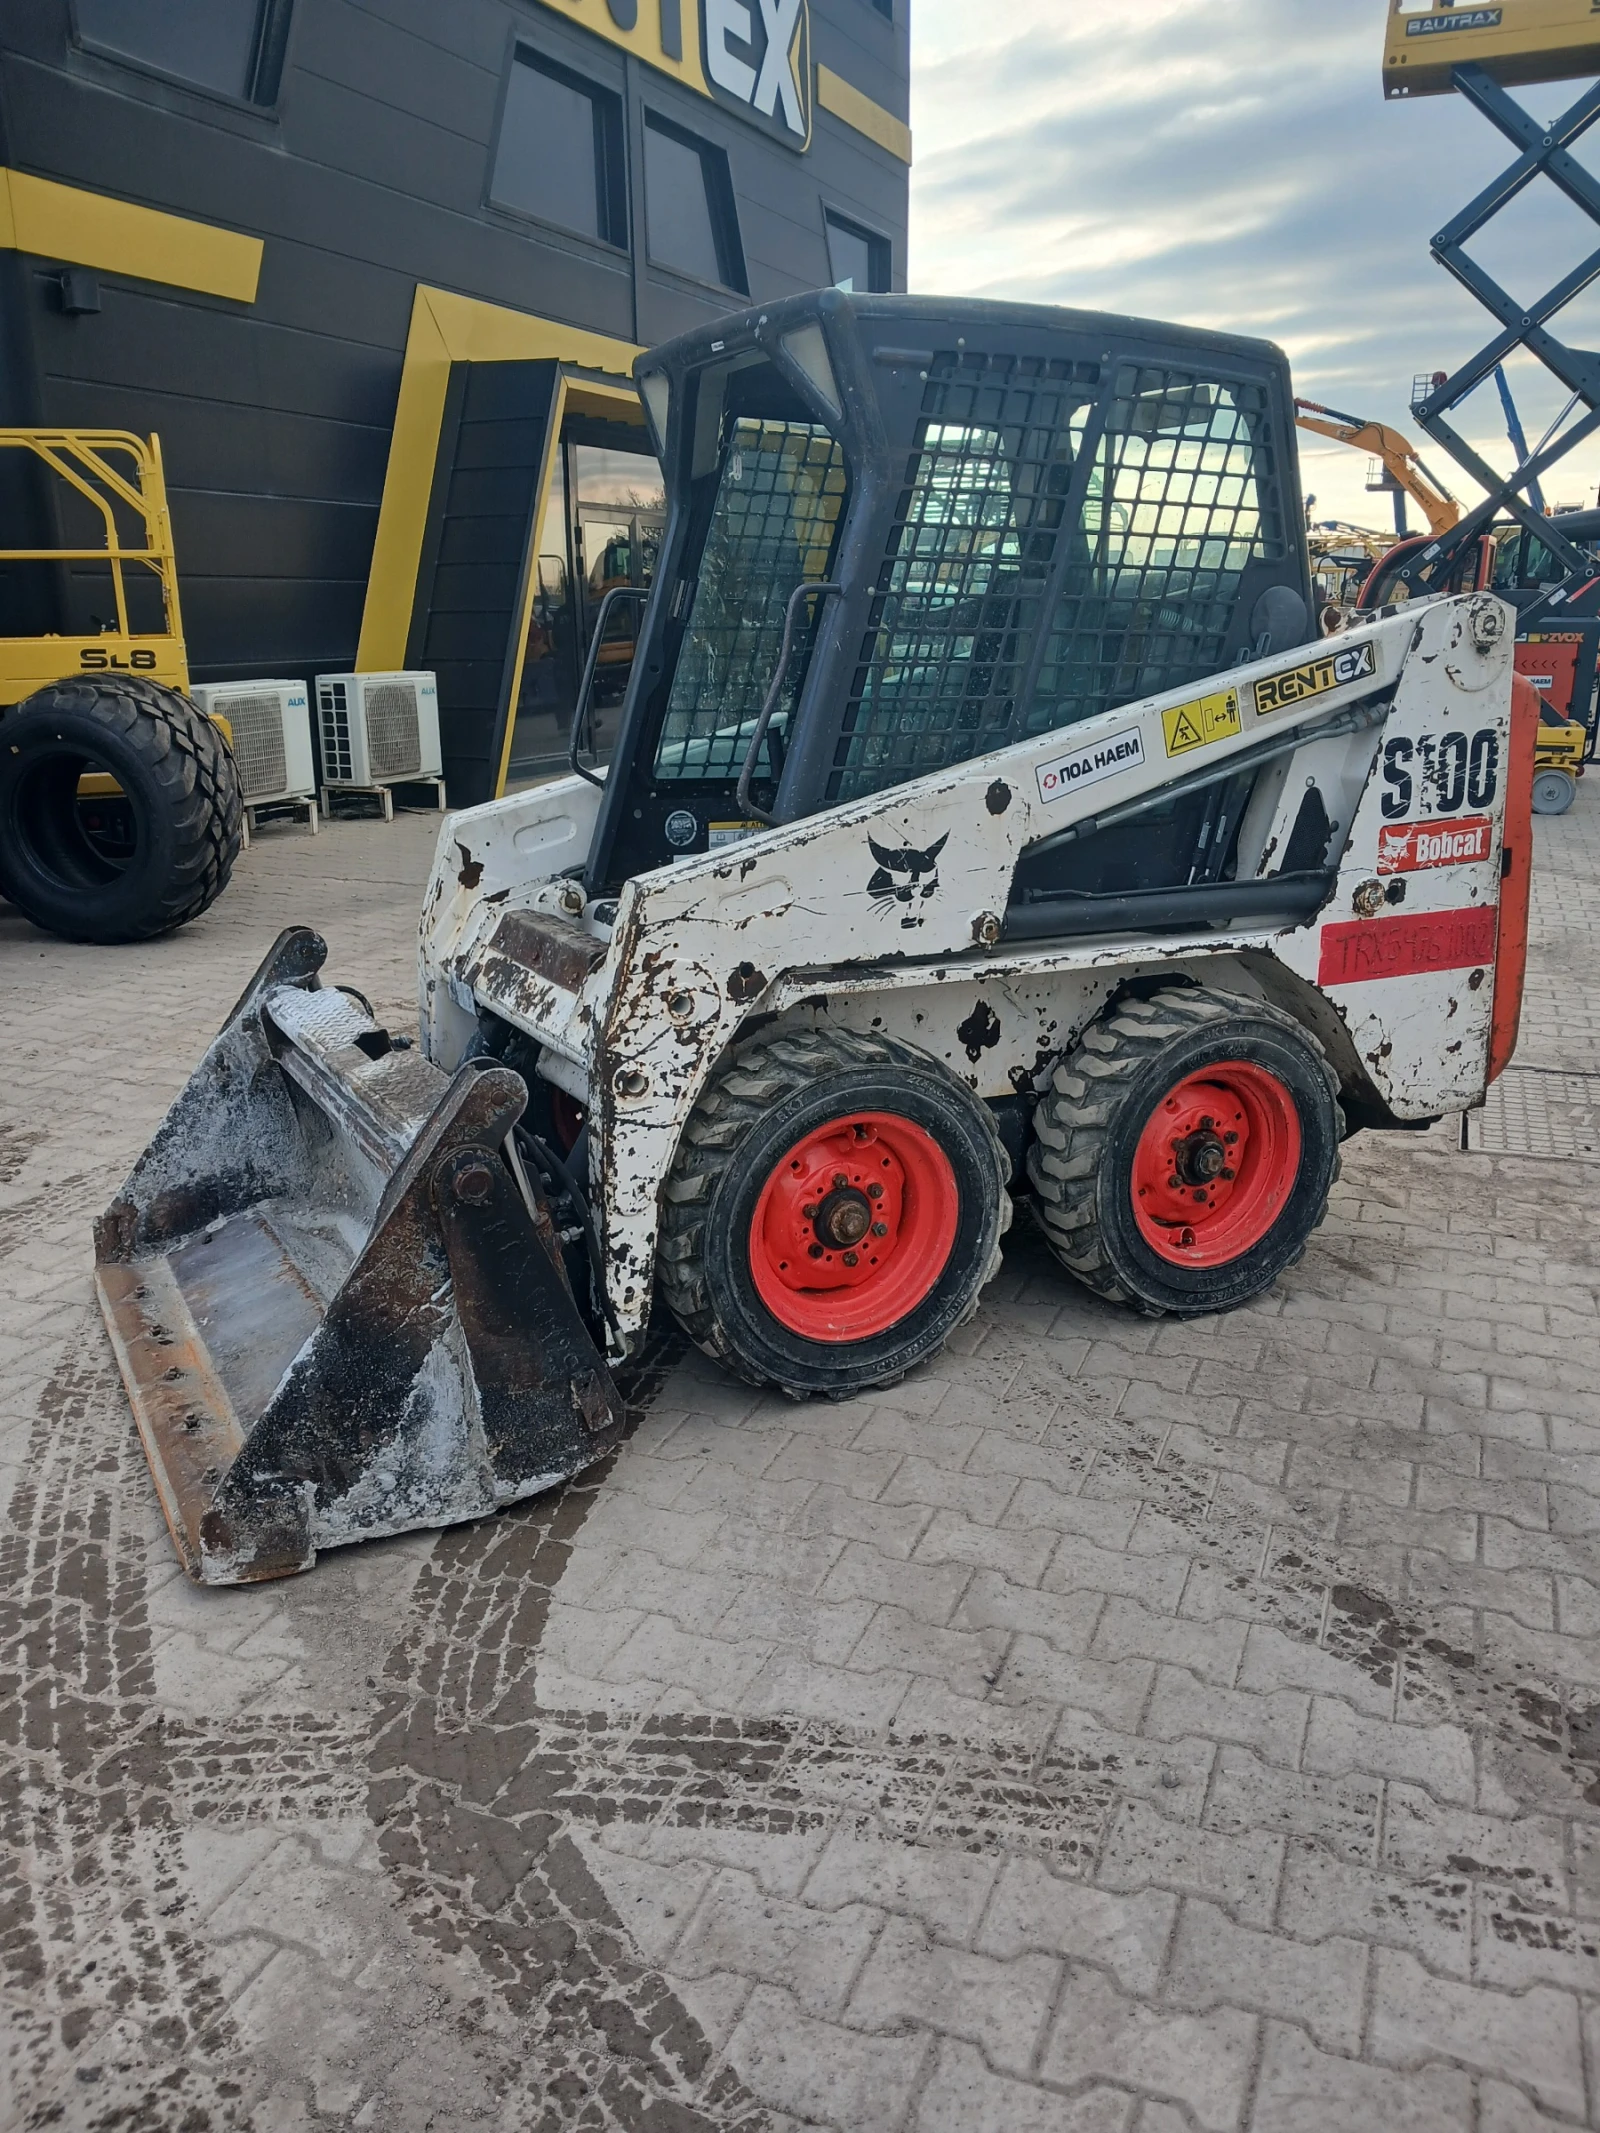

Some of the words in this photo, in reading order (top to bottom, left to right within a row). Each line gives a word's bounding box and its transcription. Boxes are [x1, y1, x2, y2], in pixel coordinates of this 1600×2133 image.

[1407, 9, 1501, 34] BAUTRAX
[1547, 632, 1585, 643] ZVOX
[79, 648, 157, 670] SL8
[1258, 645, 1374, 709] RENTEX
[287, 696, 306, 708] AUX
[420, 686, 437, 696] AUX
[1059, 761, 1094, 785] ПОД
[1094, 738, 1140, 770] НАЕМ
[1380, 728, 1500, 820] S100
[1415, 829, 1483, 863] Bobcat
